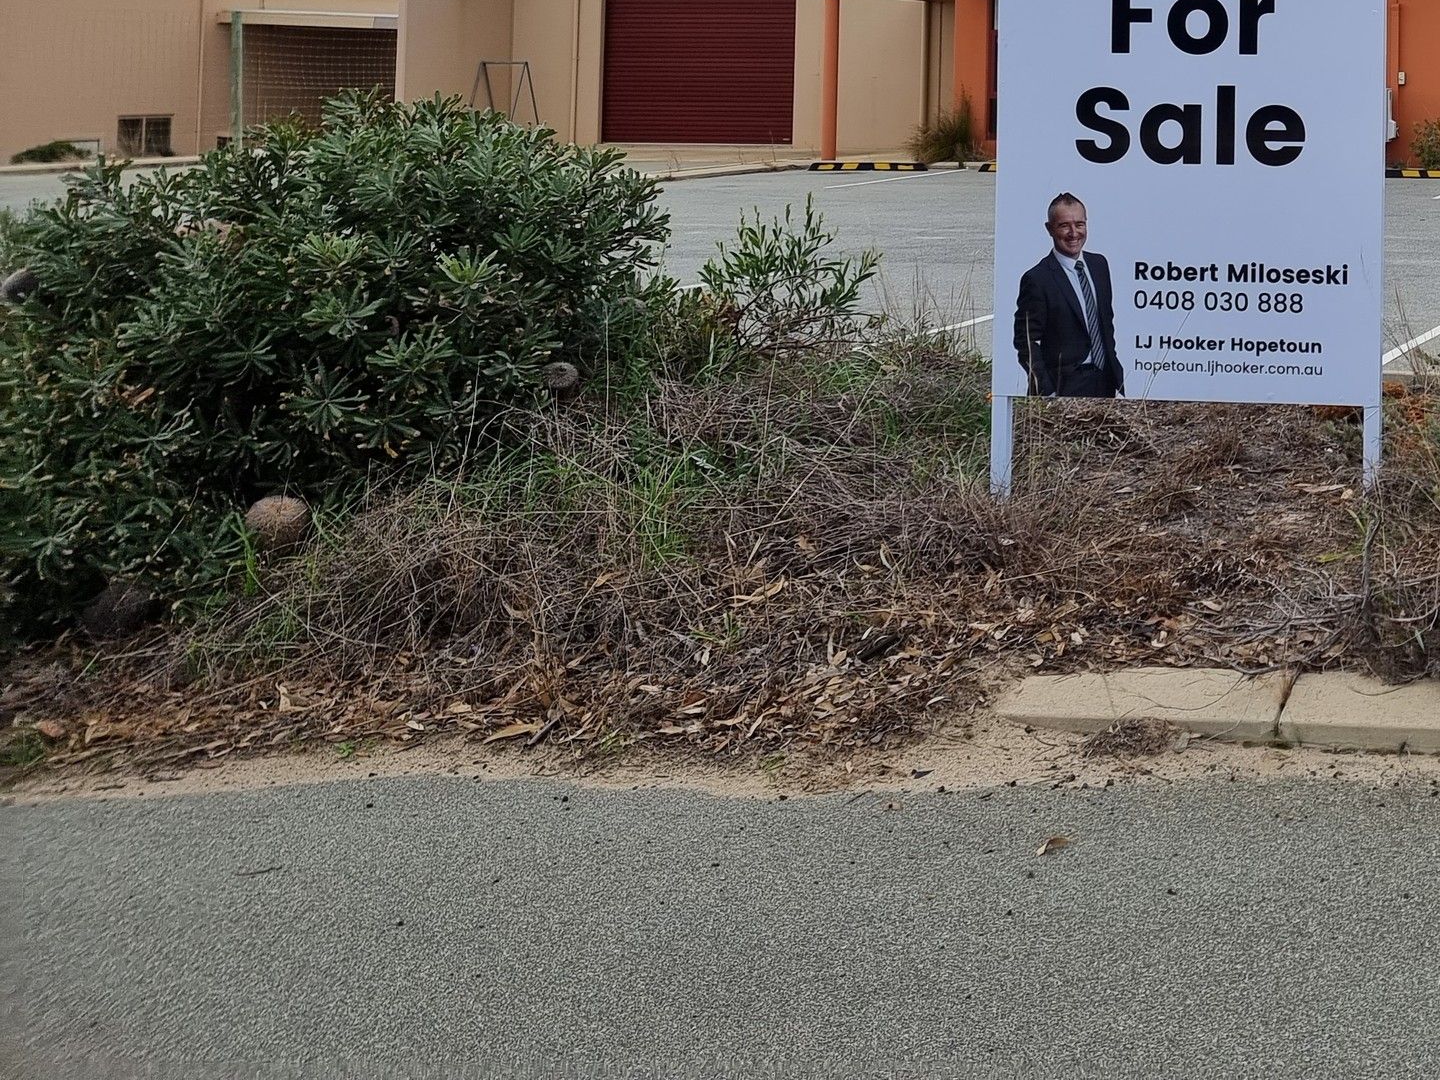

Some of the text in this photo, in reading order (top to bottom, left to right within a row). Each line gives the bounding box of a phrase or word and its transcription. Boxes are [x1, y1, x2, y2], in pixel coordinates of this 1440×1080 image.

[1075, 85, 1306, 167] Sale
[1134, 262, 1349, 285] Robert Miloseski
[1133, 290, 1304, 313] 0408 030 888
[1135, 335, 1322, 356] LJ Hooker Hopetoun
[1134, 359, 1323, 376] hopetoun.ljhooker.com.au
